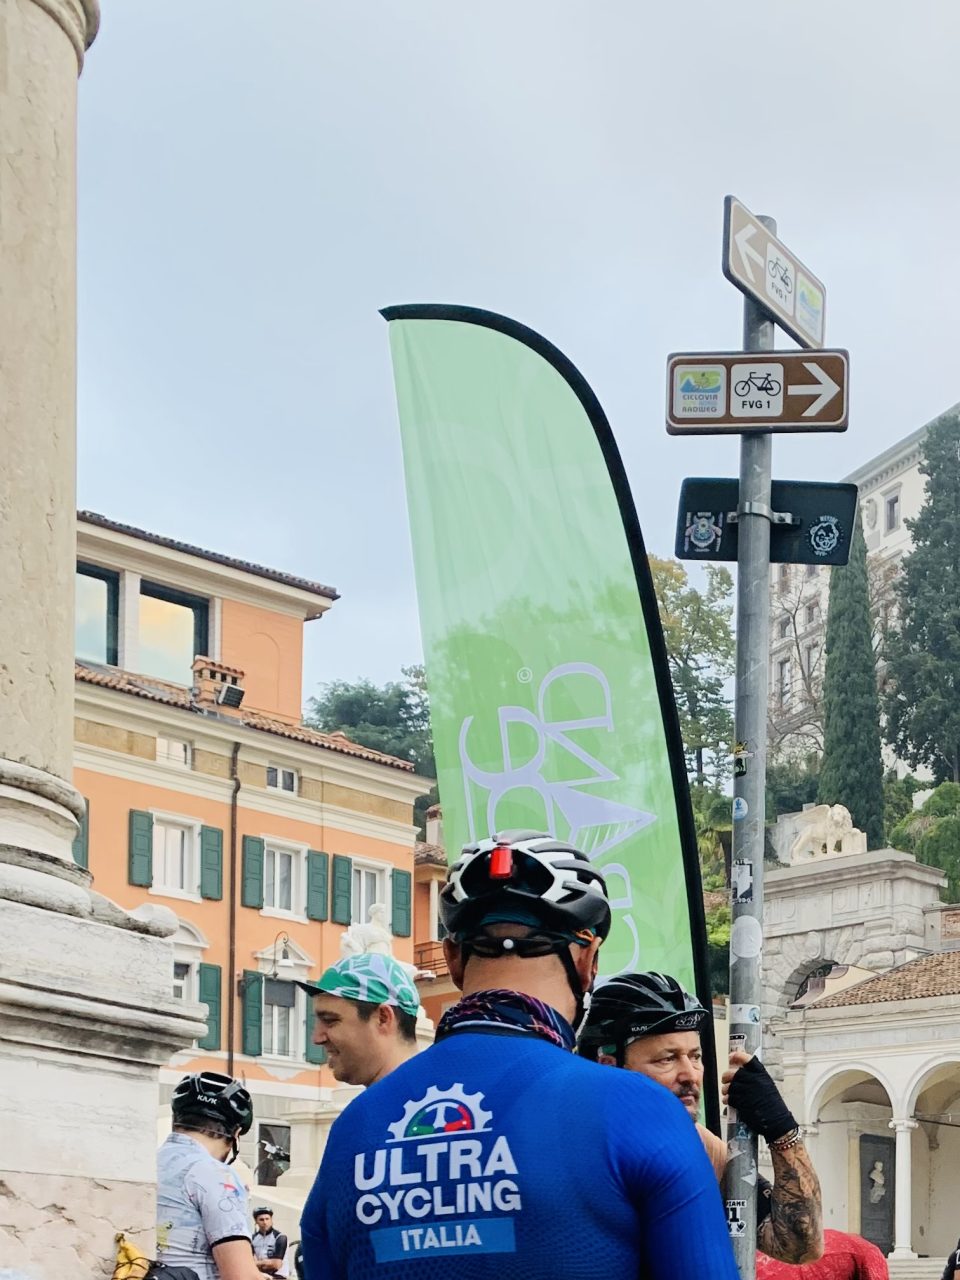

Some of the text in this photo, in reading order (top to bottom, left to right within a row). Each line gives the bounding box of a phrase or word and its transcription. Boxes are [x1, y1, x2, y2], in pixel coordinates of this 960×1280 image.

[742, 400, 770, 409] FVG 1
[197, 1094, 218, 1105] KASK
[354, 1135, 519, 1191] ULTRA
[356, 1179, 522, 1225] CYCLING
[401, 1224, 482, 1251] ITALIA
